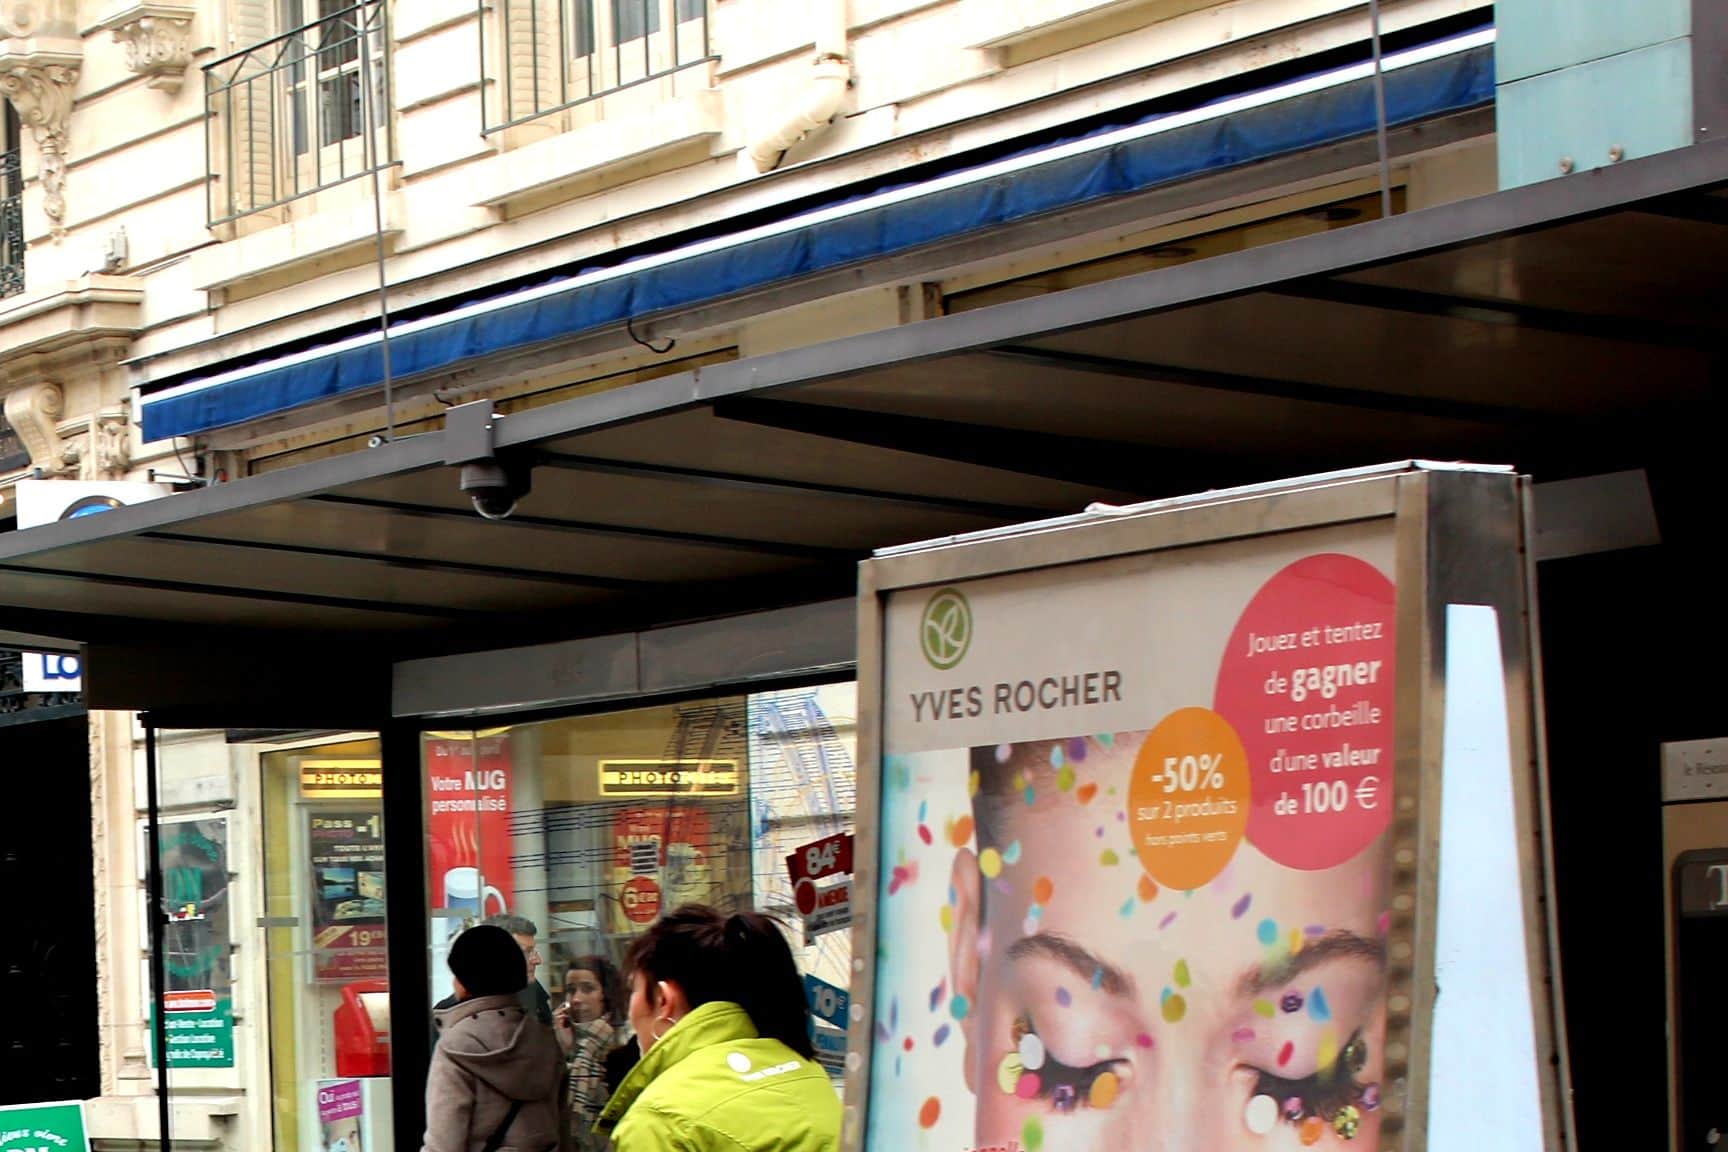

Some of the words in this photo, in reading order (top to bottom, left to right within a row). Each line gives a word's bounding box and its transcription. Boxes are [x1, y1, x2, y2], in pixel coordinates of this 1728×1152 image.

[1301, 626, 1321, 648] et
[1324, 621, 1383, 645] tentez
[909, 685, 983, 723] YVES
[994, 670, 1123, 715] ROCHER
[1263, 670, 1288, 695] de
[1290, 660, 1383, 702] gagner
[1264, 716, 1298, 735] une
[1300, 700, 1382, 732] corbeille
[1151, 752, 1225, 794] -50%
[1269, 748, 1318, 774] d'une
[1321, 743, 1383, 769] valeur
[315, 773, 369, 786] PHOTO
[431, 775, 463, 792] Votre
[464, 769, 507, 791] MUG
[1274, 792, 1299, 816] de
[1301, 779, 1348, 814] 100
[1354, 775, 1381, 810] €
[1136, 806, 1160, 822] sur
[1161, 800, 1172, 819] 2
[1174, 796, 1238, 825] produits
